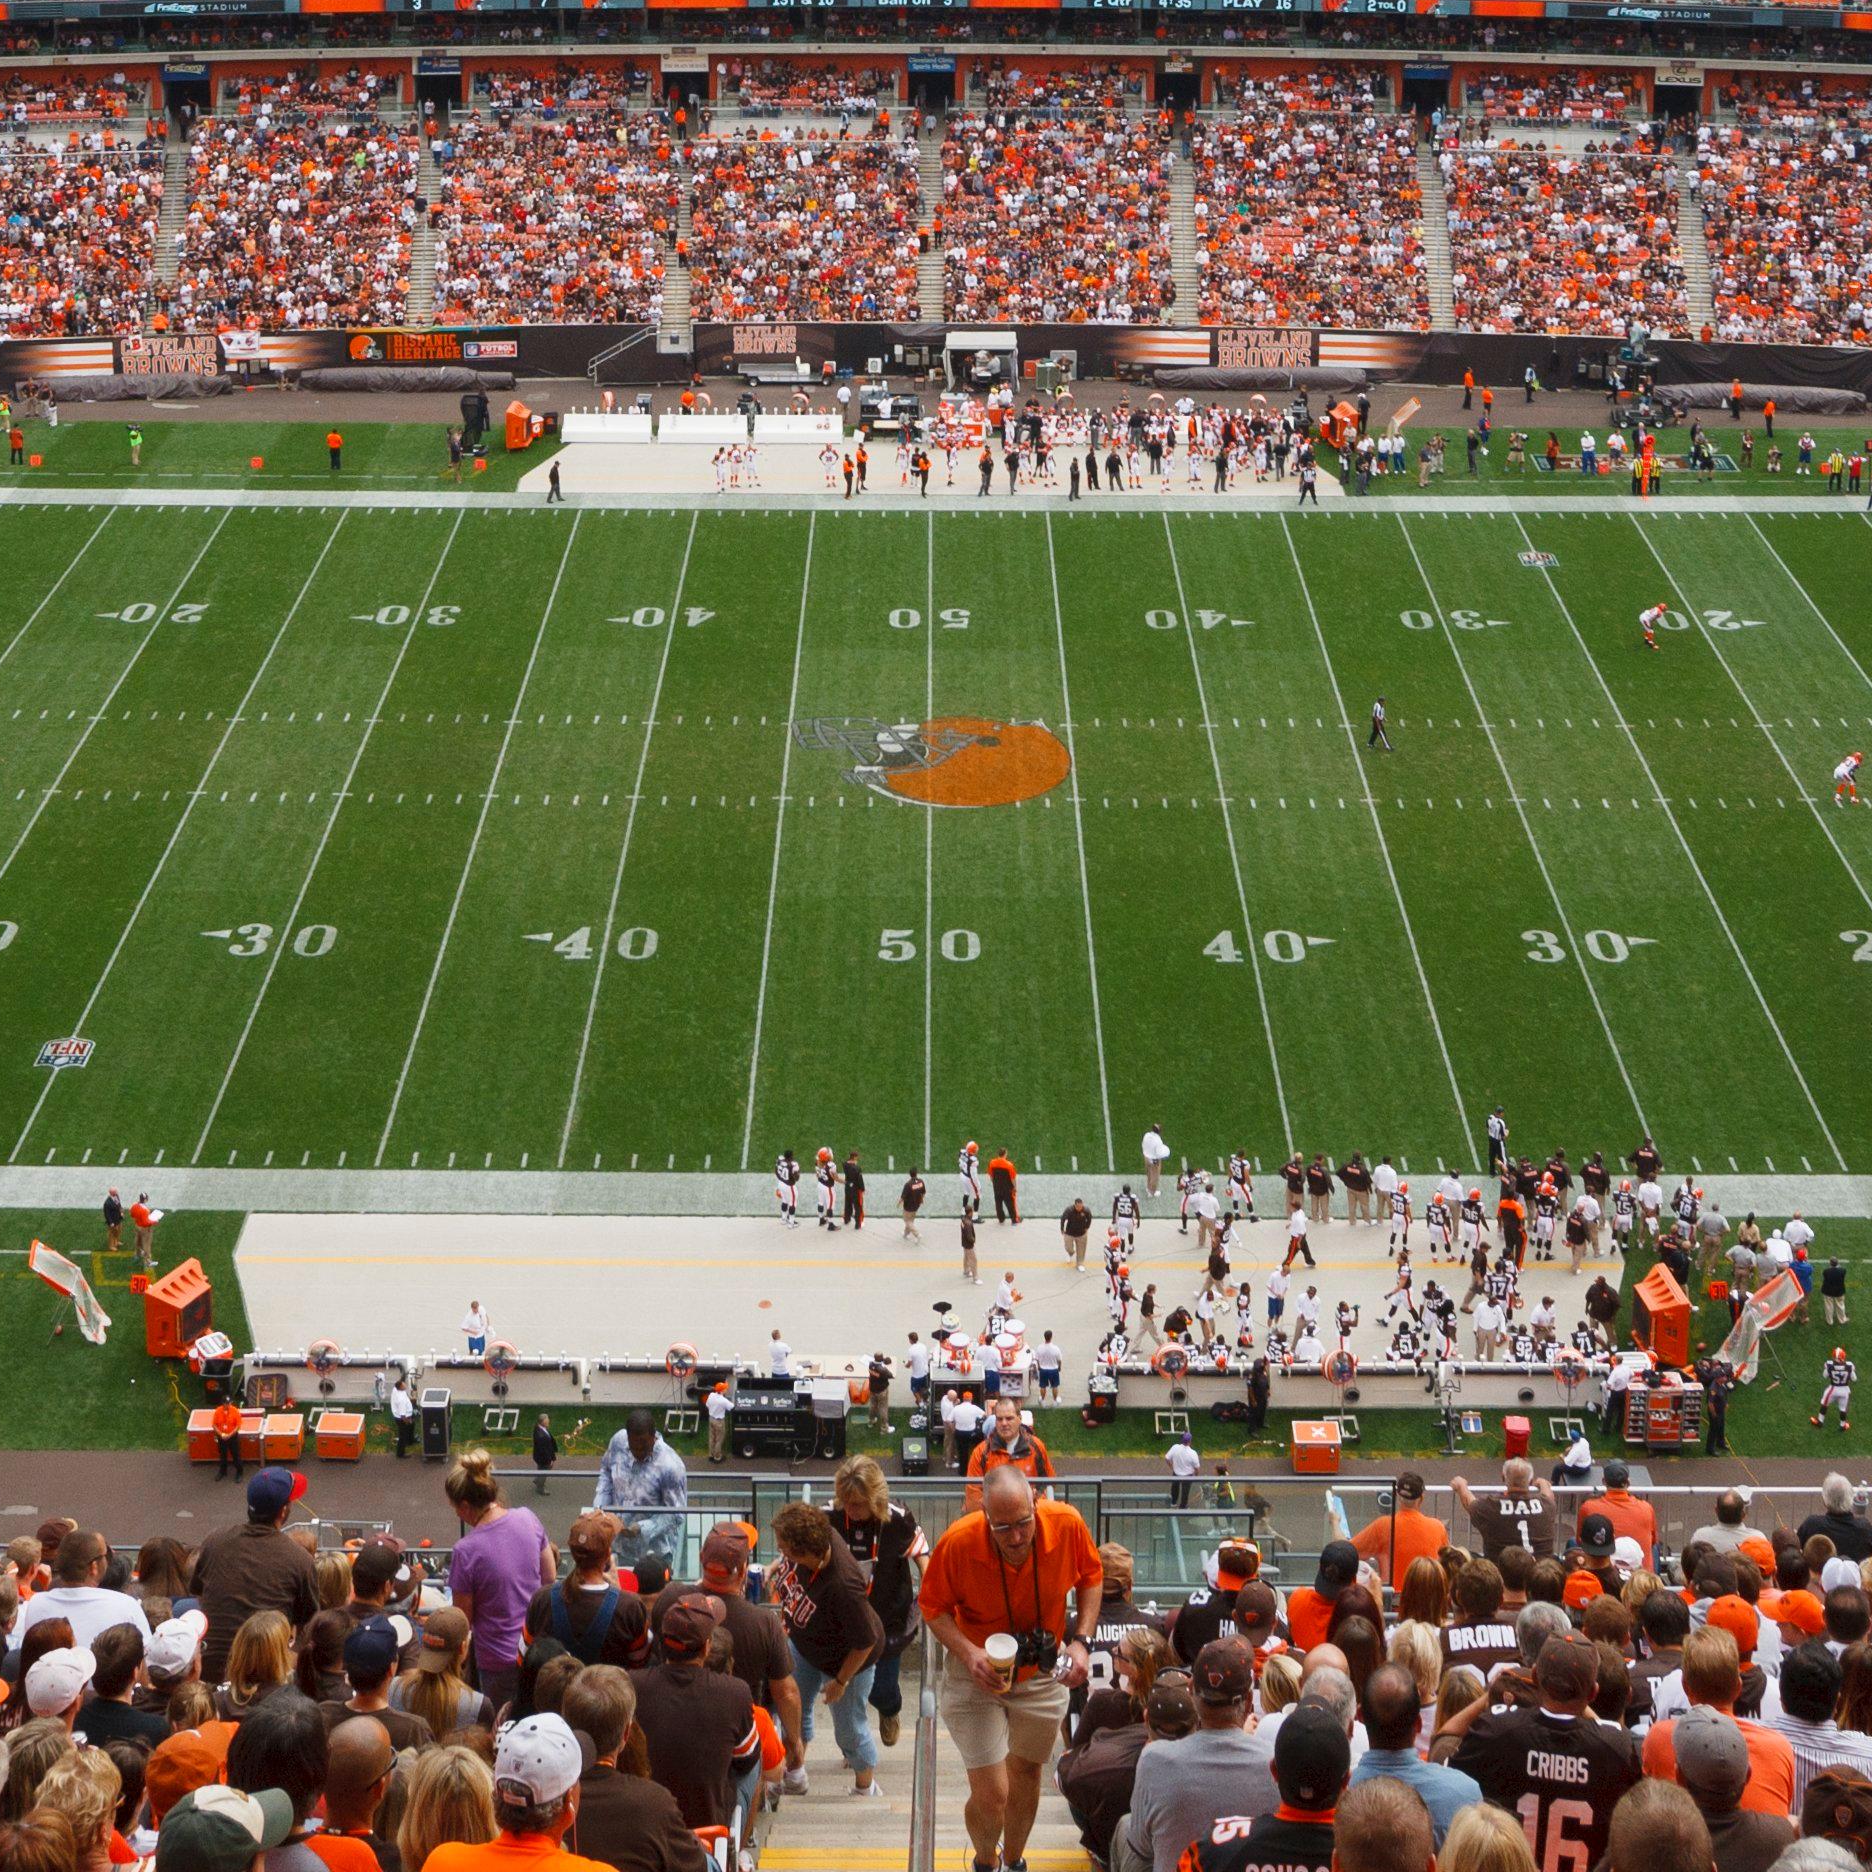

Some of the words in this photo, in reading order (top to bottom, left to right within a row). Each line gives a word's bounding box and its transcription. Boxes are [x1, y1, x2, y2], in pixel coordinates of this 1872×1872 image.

[157, 3, 200, 14] FirstEnergy
[201, 4, 247, 12] STADIUM
[1367, 0, 1377, 12] 2
[1378, 1, 1396, 10] TOL
[1396, 0, 1406, 12] 0
[1619, 7, 1661, 20] FirstEnergy
[1662, 9, 1711, 18] STADIUM
[1657, 76, 1702, 84] LEXUS
[393, 333, 457, 346] HISPANIC
[733, 326, 796, 339] CLEVELAND
[1218, 330, 1311, 347] CLEVELAND
[120, 335, 218, 356] CEVELAND
[393, 345, 462, 359] HERITAGE
[733, 338, 797, 354] BROWNS
[121, 354, 218, 377] BROWNS
[1217, 347, 1312, 368] BROWNS
[119, 602, 209, 623] 20
[375, 605, 462, 625] 30
[631, 608, 716, 628] 40
[888, 609, 970, 629] 50
[1144, 609, 1228, 629] 40
[1399, 610, 1484, 630] 30
[1657, 610, 1742, 630] 20
[228, 923, 338, 957] 30
[553, 926, 659, 960] 40
[878, 928, 981, 962] 50
[1201, 930, 1307, 963] 40
[1520, 929, 1630, 963] 30
[1489, 1281, 1506, 1295] 17
[773, 1397, 793, 1405] Surface
[1499, 1499, 1544, 1515] DAD
[1516, 1520, 1534, 1554] 1
[1448, 1624, 1518, 1651] BROWN
[1527, 1750, 1590, 1784] CRIBBS
[1516, 1792, 1594, 1872] 16
